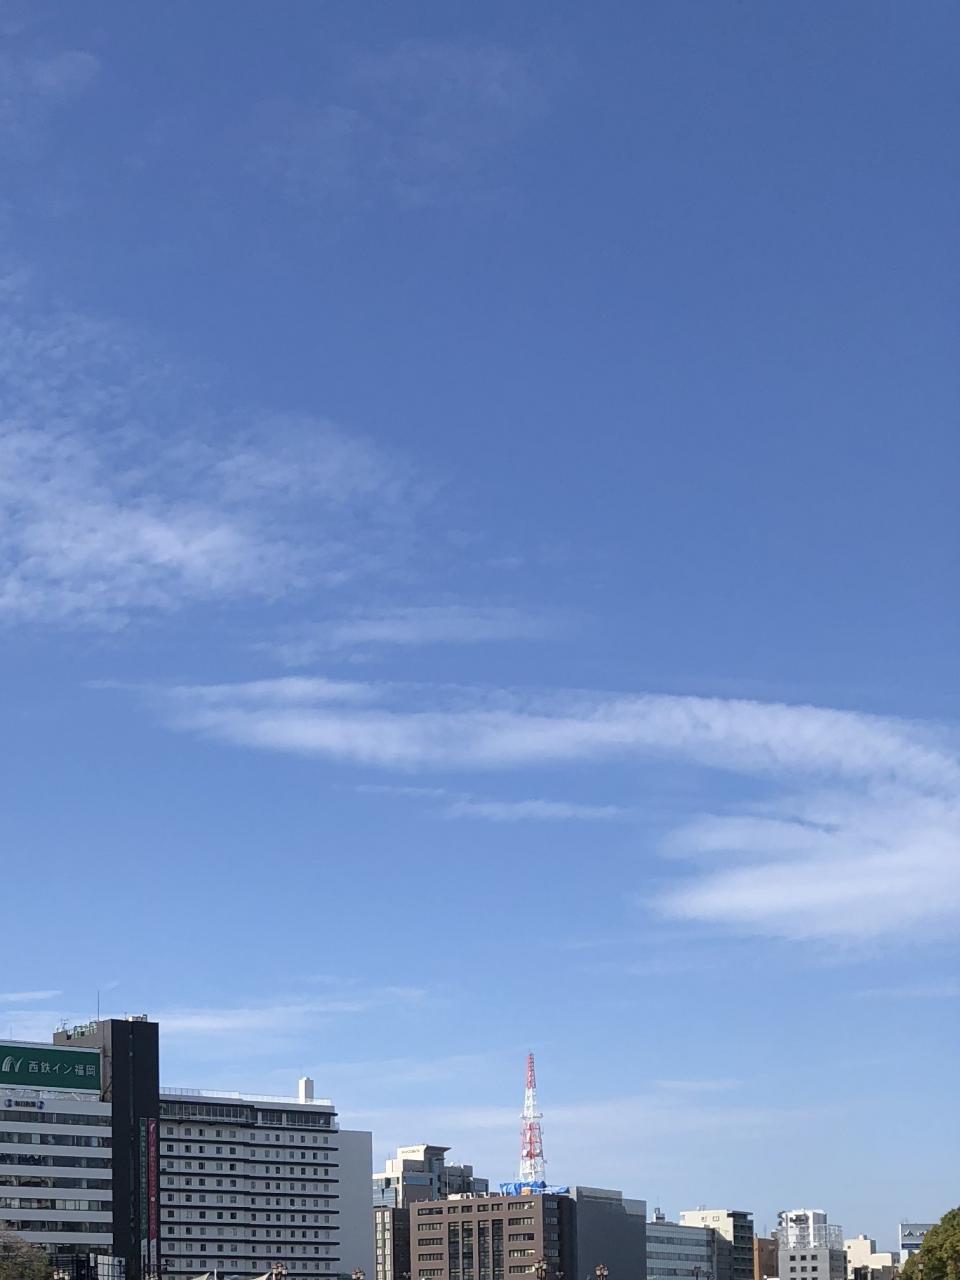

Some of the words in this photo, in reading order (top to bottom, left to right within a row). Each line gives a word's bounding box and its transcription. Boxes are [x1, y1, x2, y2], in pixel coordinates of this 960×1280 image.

[28, 1060, 96, 1077] 西鉄イン福岡
